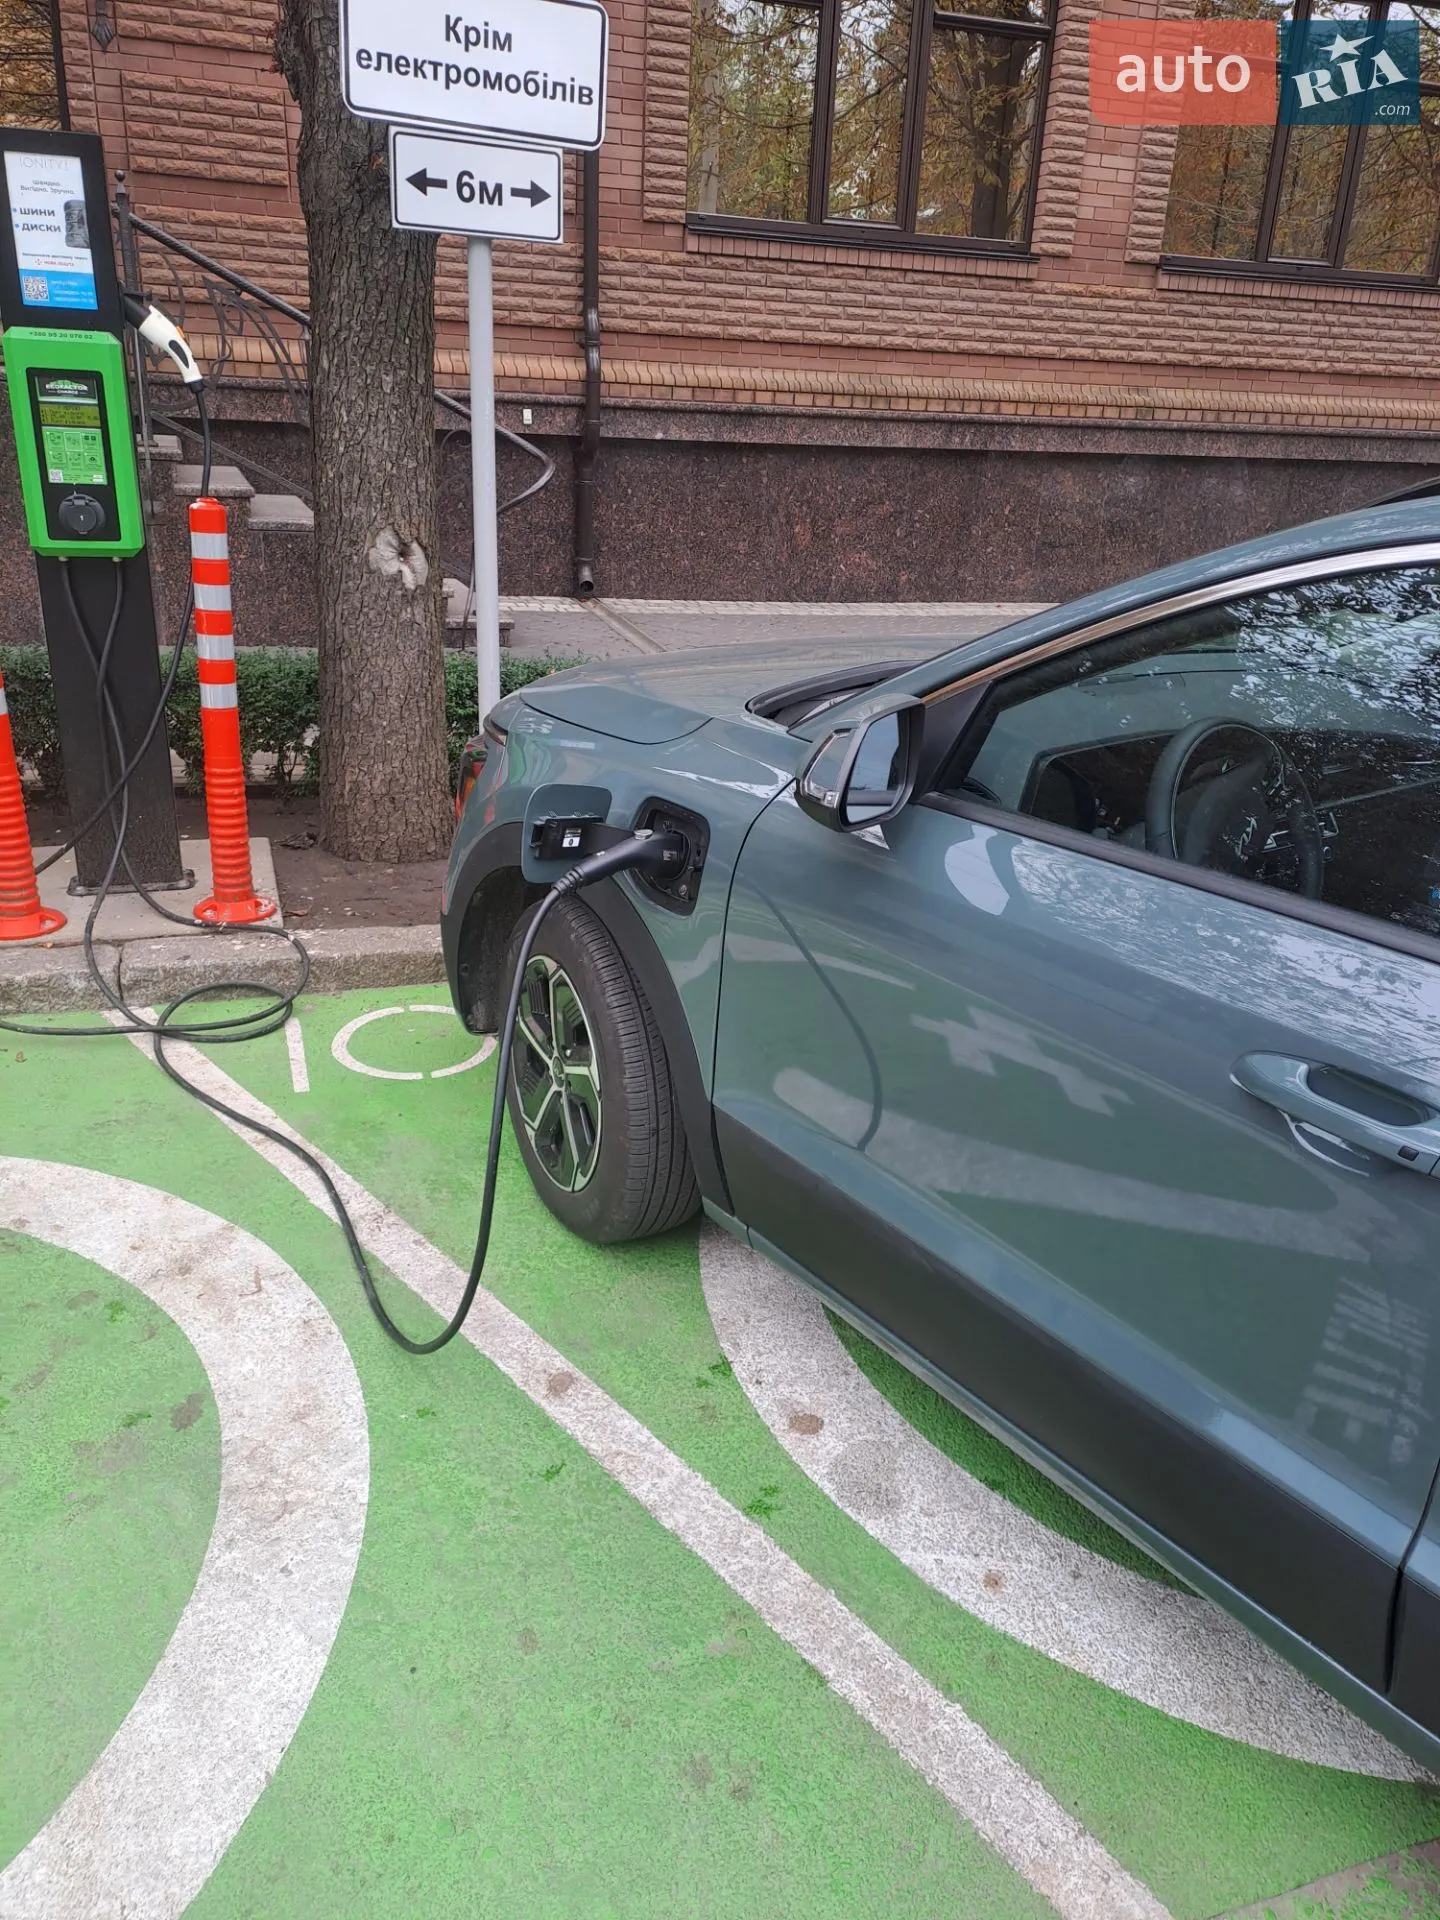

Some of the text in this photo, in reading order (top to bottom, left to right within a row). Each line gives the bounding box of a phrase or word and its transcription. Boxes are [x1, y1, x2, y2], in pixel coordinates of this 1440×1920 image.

[445, 14, 512, 52] Крім
[355, 47, 594, 106] електромобілів
[456, 170, 503, 206] 6м
